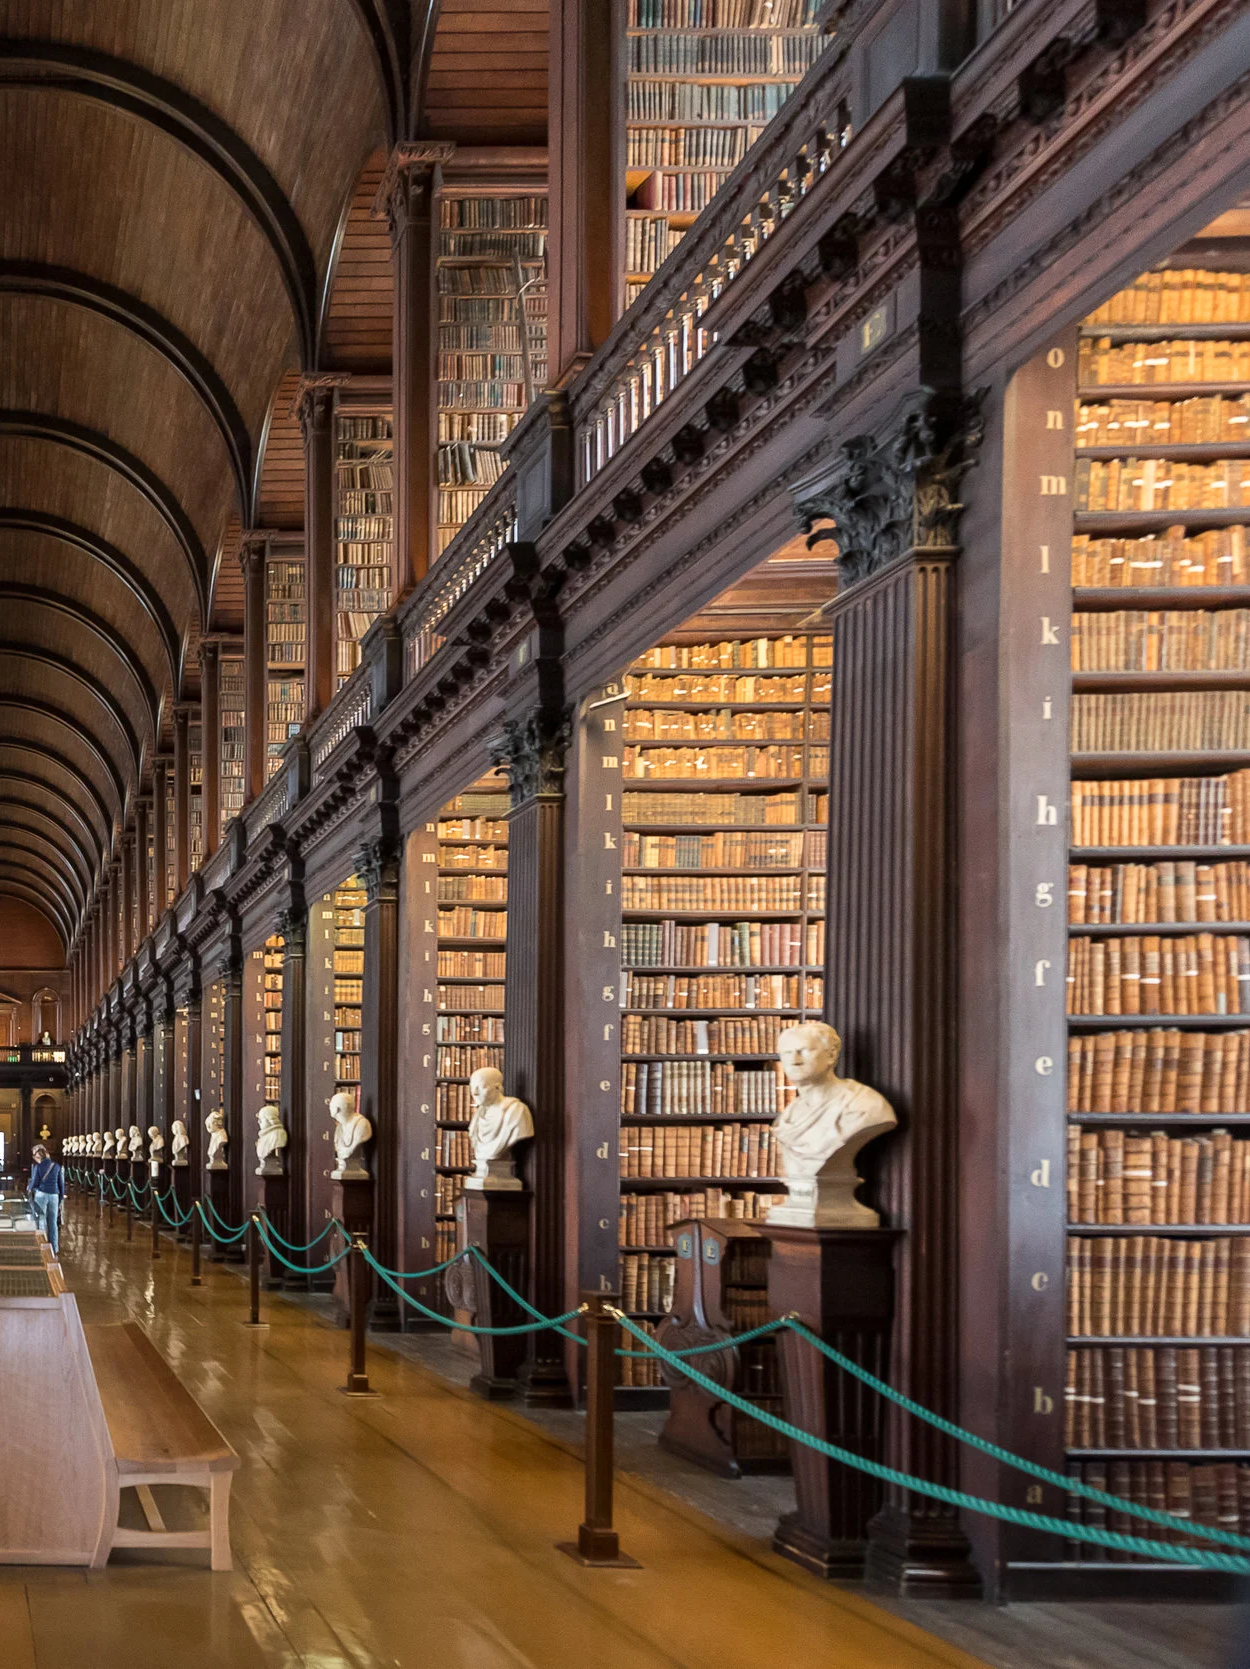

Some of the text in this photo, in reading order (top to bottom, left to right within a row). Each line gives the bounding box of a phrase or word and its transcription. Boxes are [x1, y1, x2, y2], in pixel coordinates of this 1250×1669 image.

[1046, 348, 1065, 369] o
[1046, 410, 1064, 430] n
[1040, 475, 1066, 495] m
[1039, 545, 1050, 573] l
[1041, 617, 1060, 644] k
[1043, 696, 1052, 719] i
[604, 719, 616, 731] n
[602, 756, 619, 768] m
[605, 794, 612, 811] l
[1036, 795, 1058, 825] h
[604, 832, 617, 849] k
[606, 880, 613, 894] i
[1036, 882, 1054, 907] g
[603, 931, 616, 948] h
[1035, 960, 1051, 986] f
[602, 986, 614, 1002] g
[604, 1024, 614, 1041] f
[1035, 1056, 1053, 1075] e
[600, 1080, 611, 1091] e
[596, 1142, 609, 1159] d
[1031, 1159, 1050, 1188] d
[599, 1218, 609, 1229] c
[1031, 1272, 1049, 1291] c
